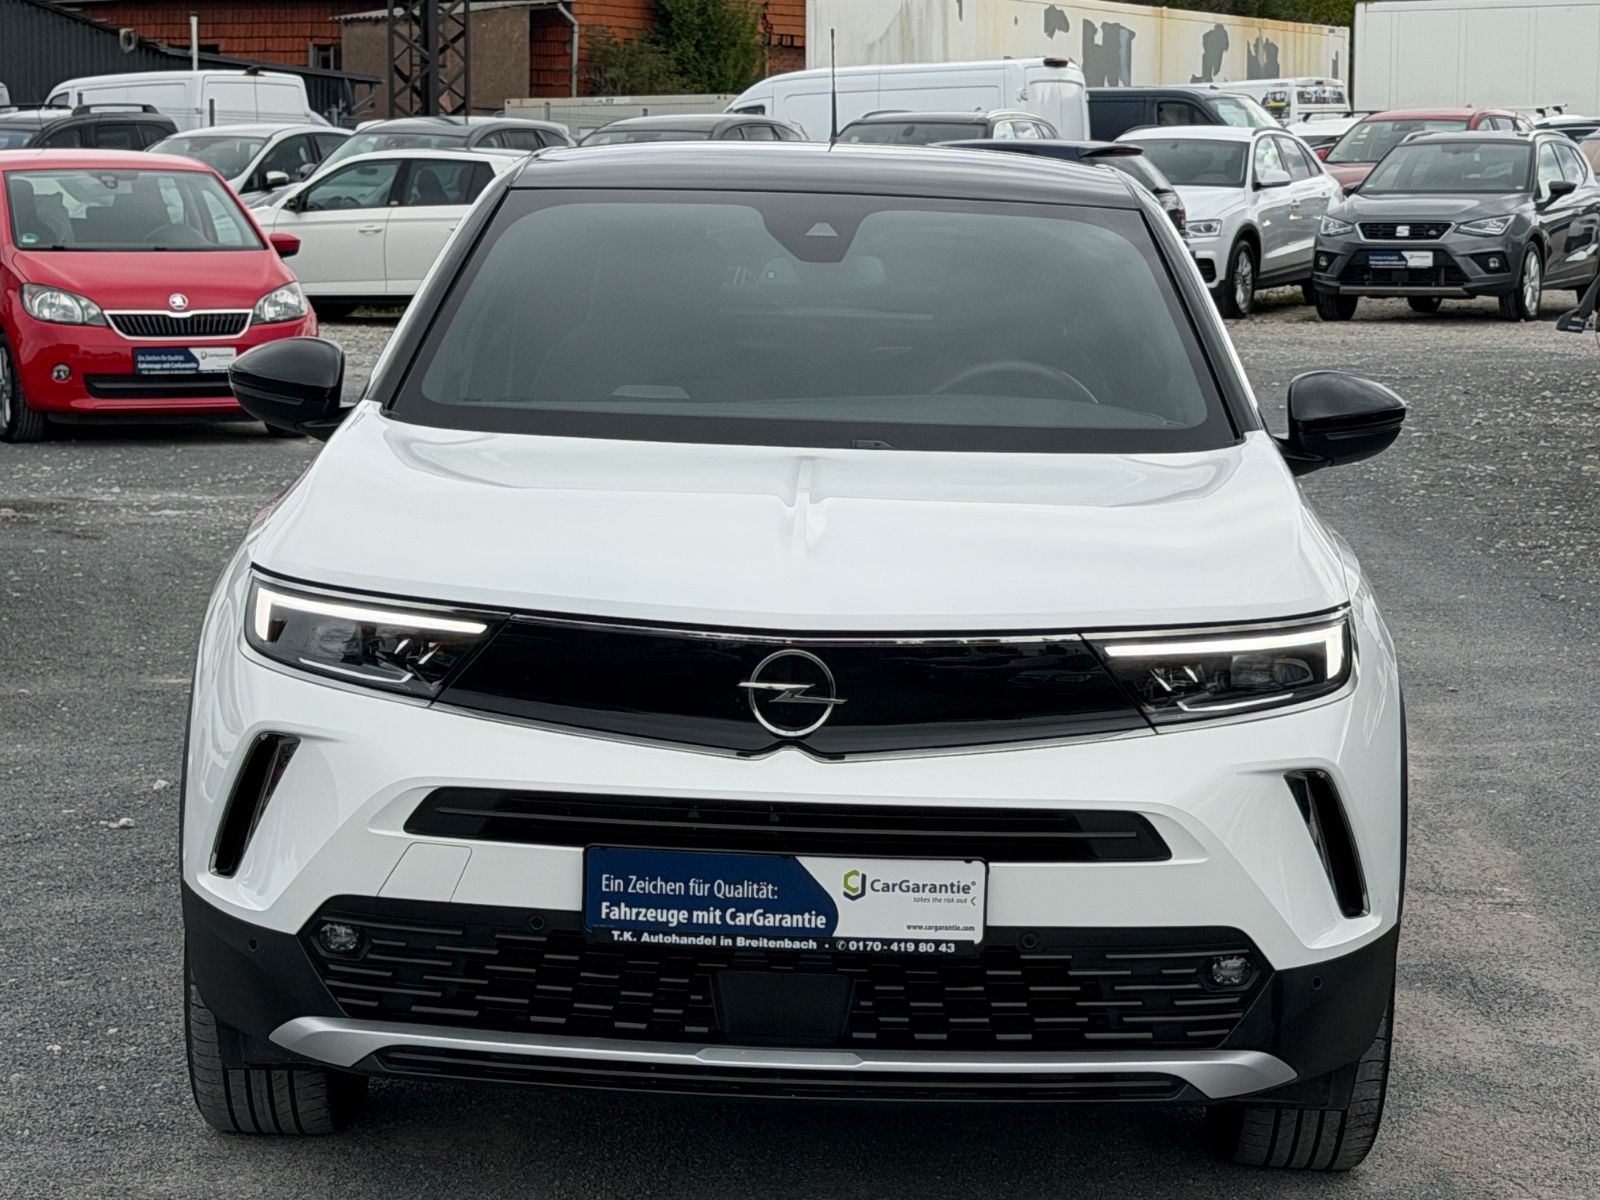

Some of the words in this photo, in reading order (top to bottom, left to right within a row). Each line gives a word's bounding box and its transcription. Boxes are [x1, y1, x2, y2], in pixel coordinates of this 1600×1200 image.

[601, 874, 624, 892] Ein
[627, 875, 685, 895] Zeichen
[689, 878, 711, 897] für
[713, 879, 778, 900] Qualität:
[931, 896, 942, 904] the
[601, 901, 689, 927] Fahrzeuge
[692, 906, 722, 925] mit
[725, 907, 827, 929] CarGarantie
[906, 924, 976, 933] www.cargarantie.com
[611, 930, 637, 942] T.K.
[640, 932, 717, 946] Autohandel
[720, 936, 732, 946] in
[736, 936, 817, 949] Breitenbach
